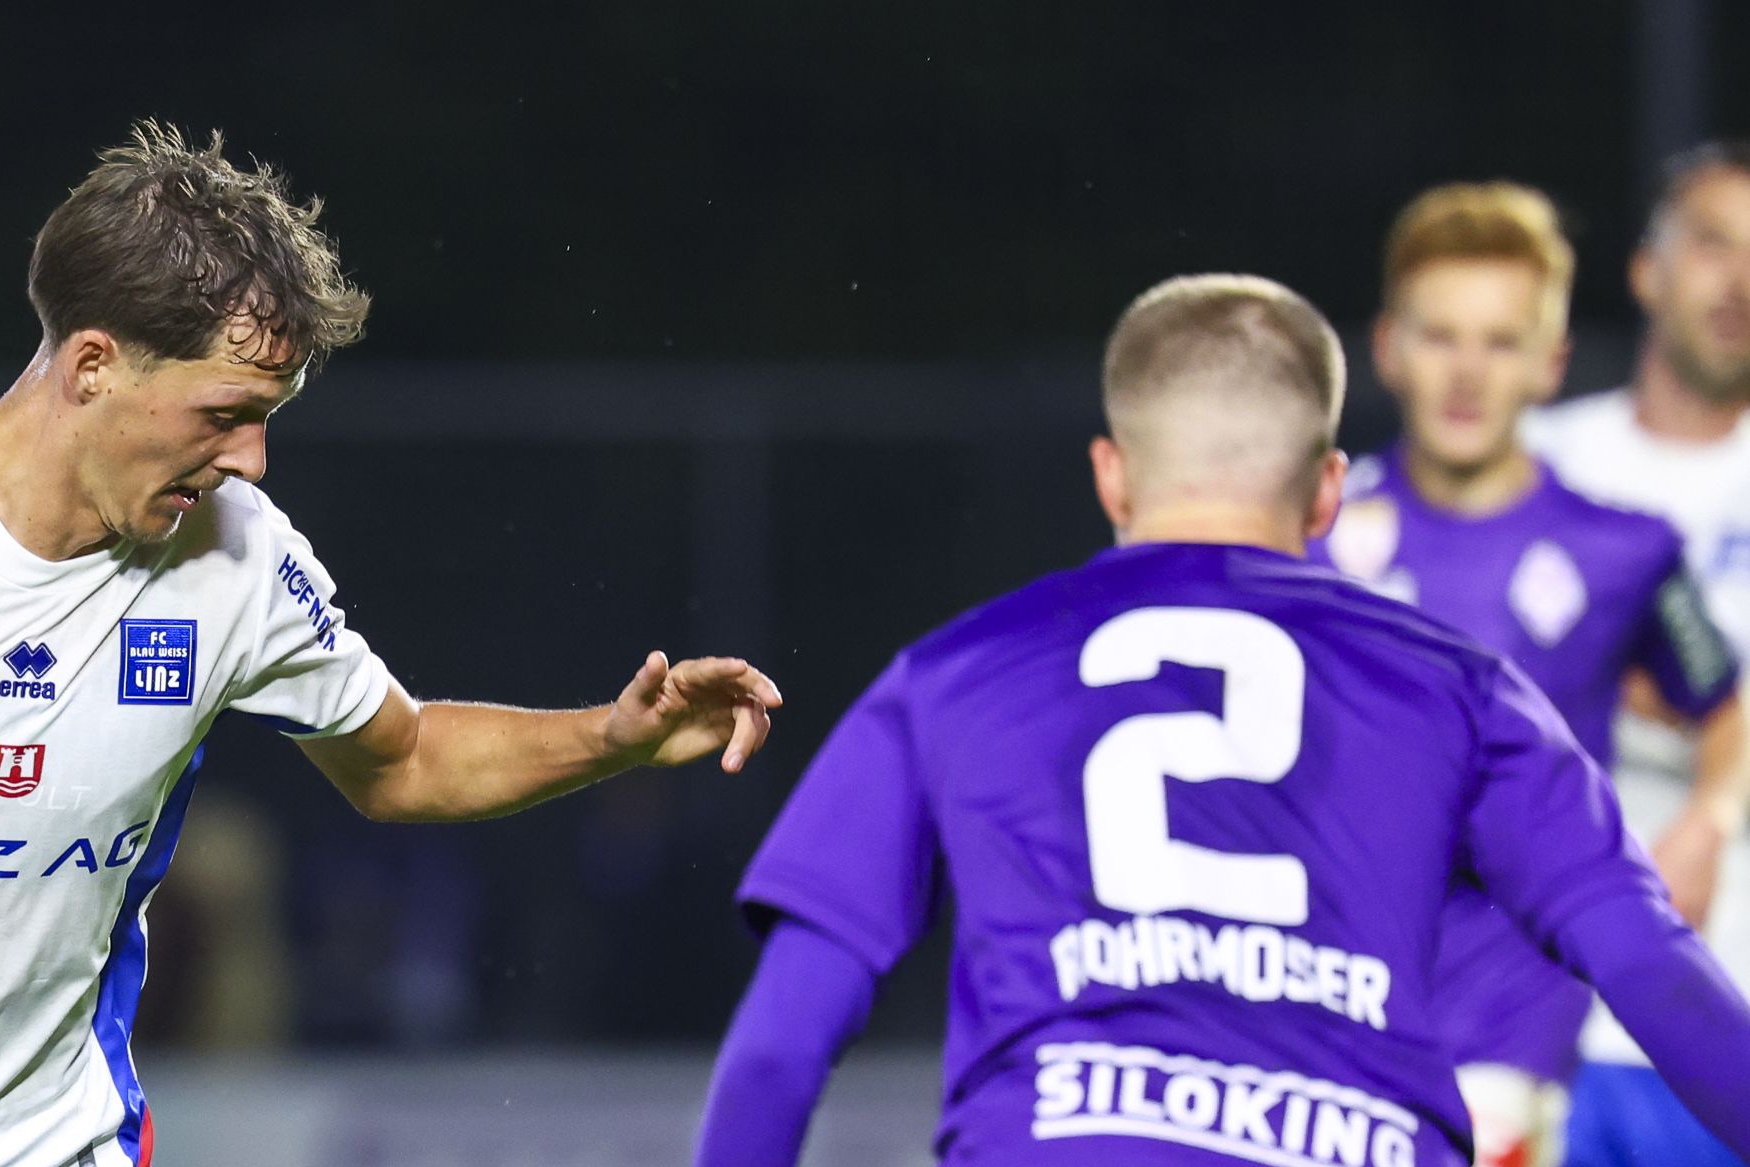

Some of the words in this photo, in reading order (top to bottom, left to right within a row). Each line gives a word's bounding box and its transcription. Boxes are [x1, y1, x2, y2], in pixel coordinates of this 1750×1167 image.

[150, 631, 167, 645] FC
[130, 647, 155, 658] BLAU
[158, 647, 188, 658] WEISS
[0, 679, 56, 700] errea
[135, 665, 180, 692] LINZ
[1080, 606, 1308, 926] 2
[40, 820, 150, 877] AG
